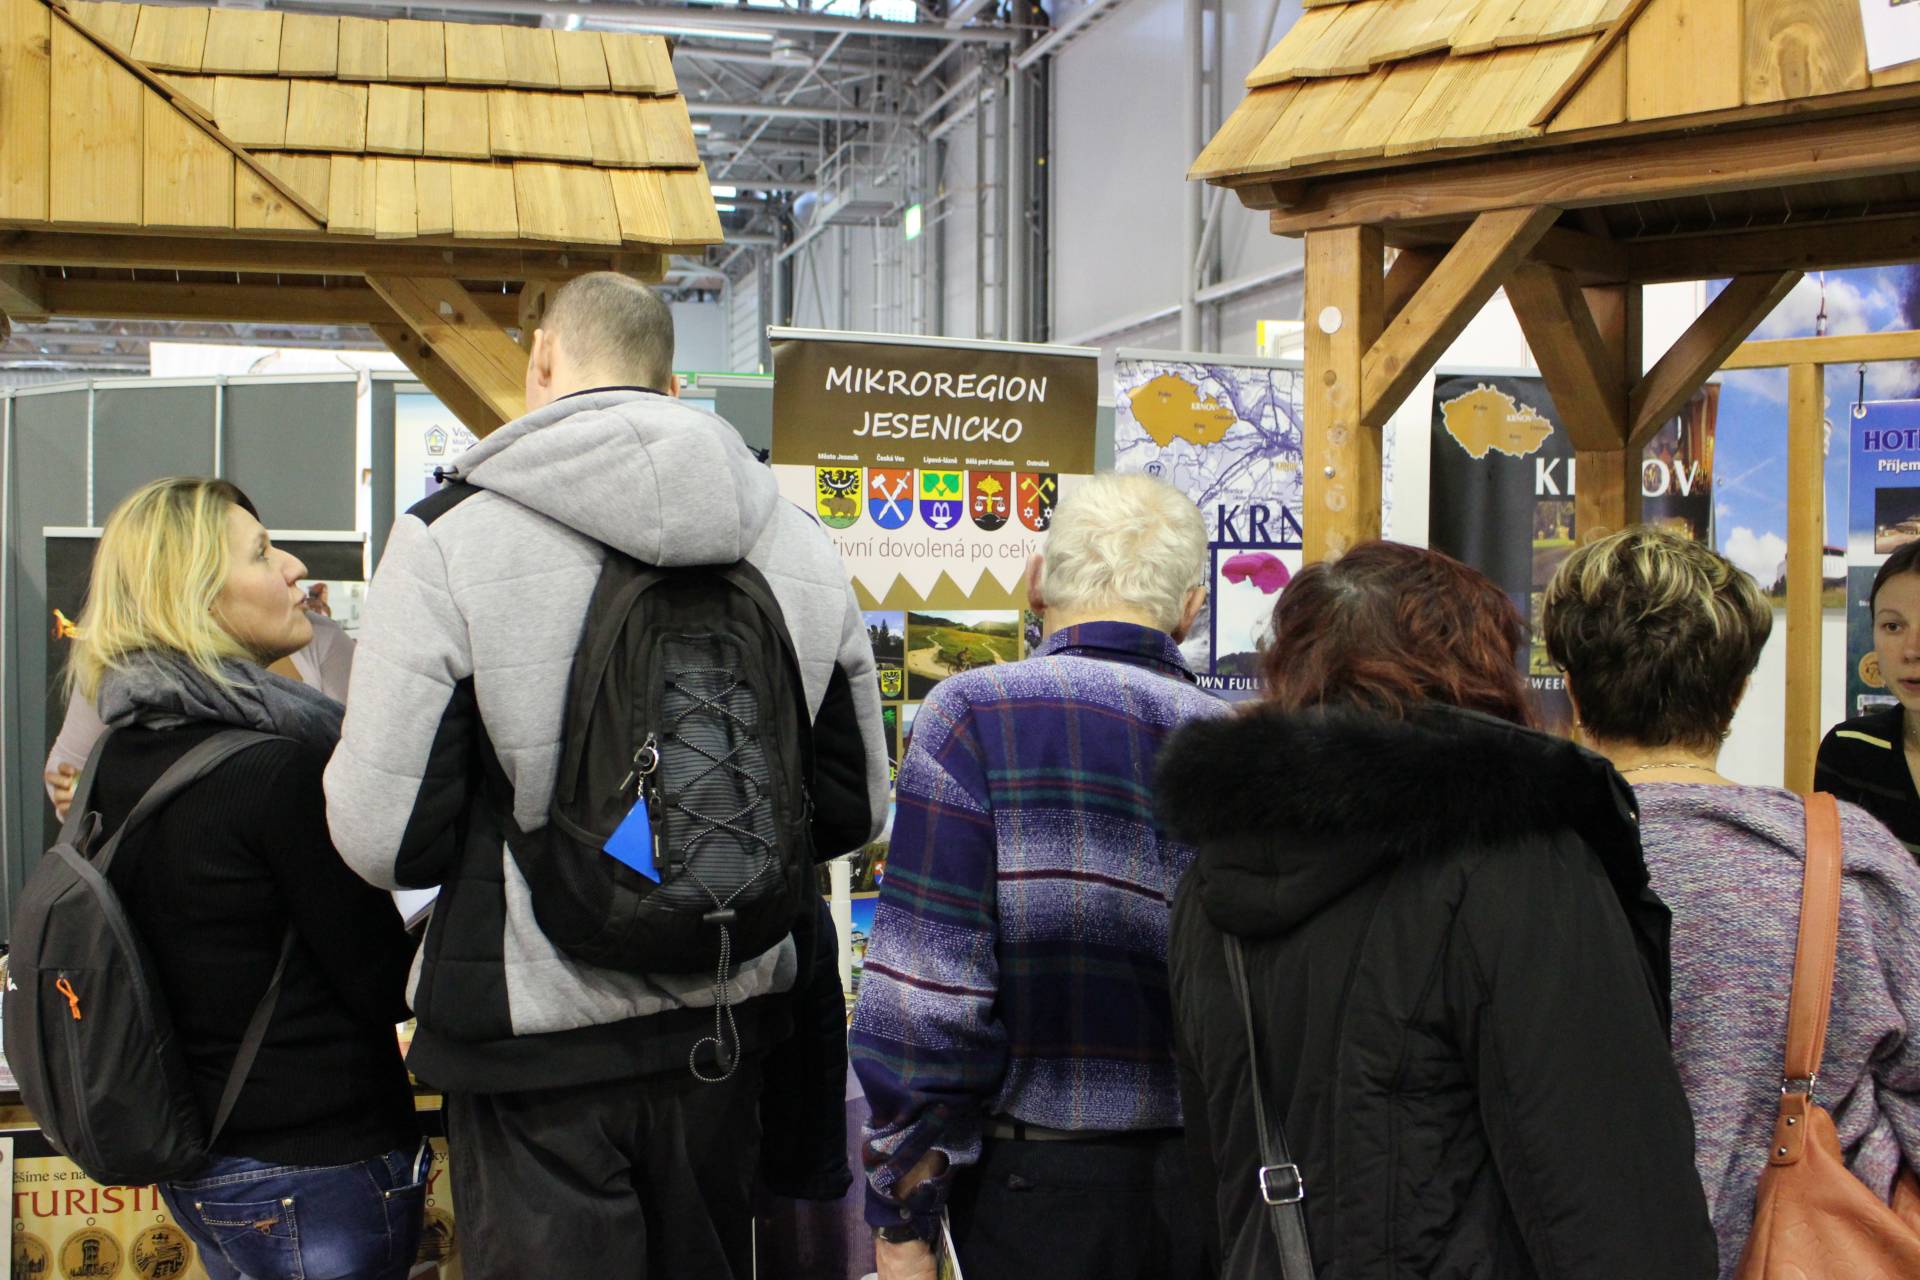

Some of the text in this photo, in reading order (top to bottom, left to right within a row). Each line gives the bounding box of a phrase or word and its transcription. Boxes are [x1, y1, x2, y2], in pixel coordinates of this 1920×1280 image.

[825, 365, 1047, 402] MIKROREGION
[853, 411, 1023, 443] JESENICKO
[1863, 429, 1920, 451] HOT
[1535, 457, 1698, 497] KOV
[879, 537, 965, 558] dovolená
[972, 543, 993, 562] po
[53, 1171, 67, 1182] se
